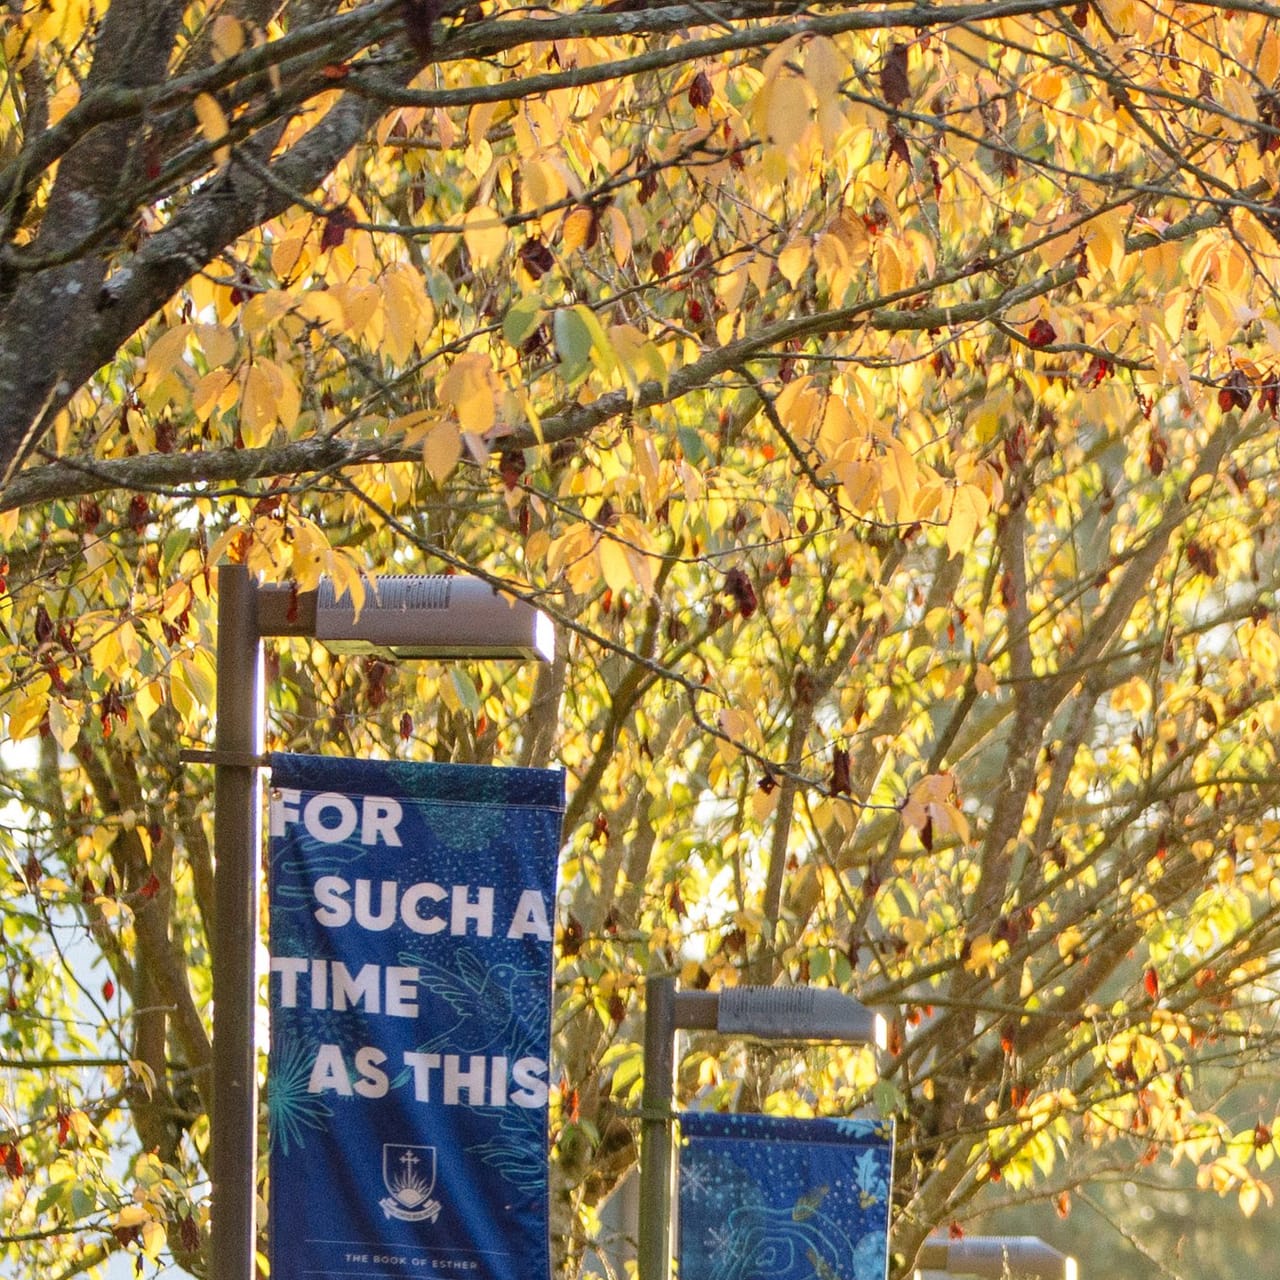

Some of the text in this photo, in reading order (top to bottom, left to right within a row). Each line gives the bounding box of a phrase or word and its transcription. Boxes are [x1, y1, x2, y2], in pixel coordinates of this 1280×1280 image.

[270, 787, 403, 847] FOR
[313, 876, 553, 942] SUCH A
[270, 957, 421, 1018] TIME
[308, 1044, 548, 1108] AS THIS
[345, 1254, 478, 1270] THE BOOK OF ESTHER
